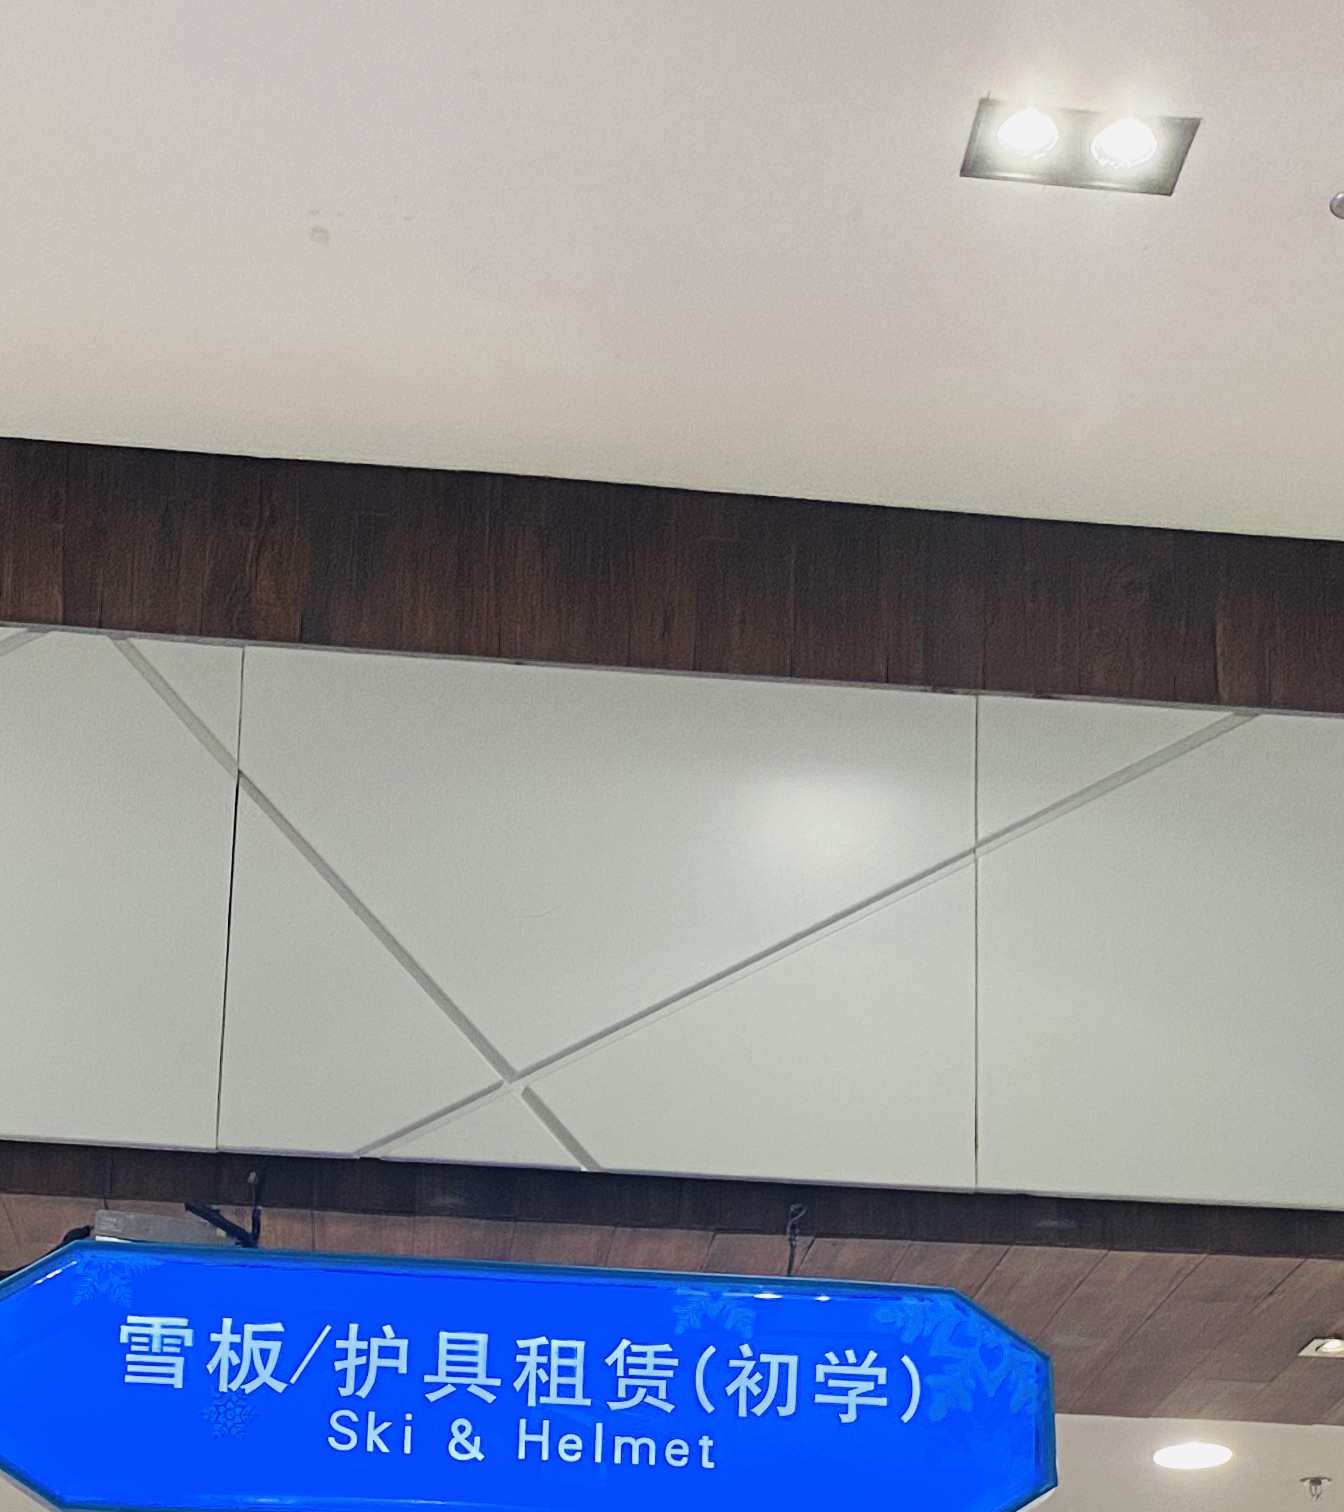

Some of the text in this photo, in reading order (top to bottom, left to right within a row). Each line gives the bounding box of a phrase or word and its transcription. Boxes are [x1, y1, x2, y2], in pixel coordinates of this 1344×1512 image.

[119, 1314, 921, 1424] 雪板/护具租赁(初学)
[327, 1408, 716, 1469] Ski & Helmet
